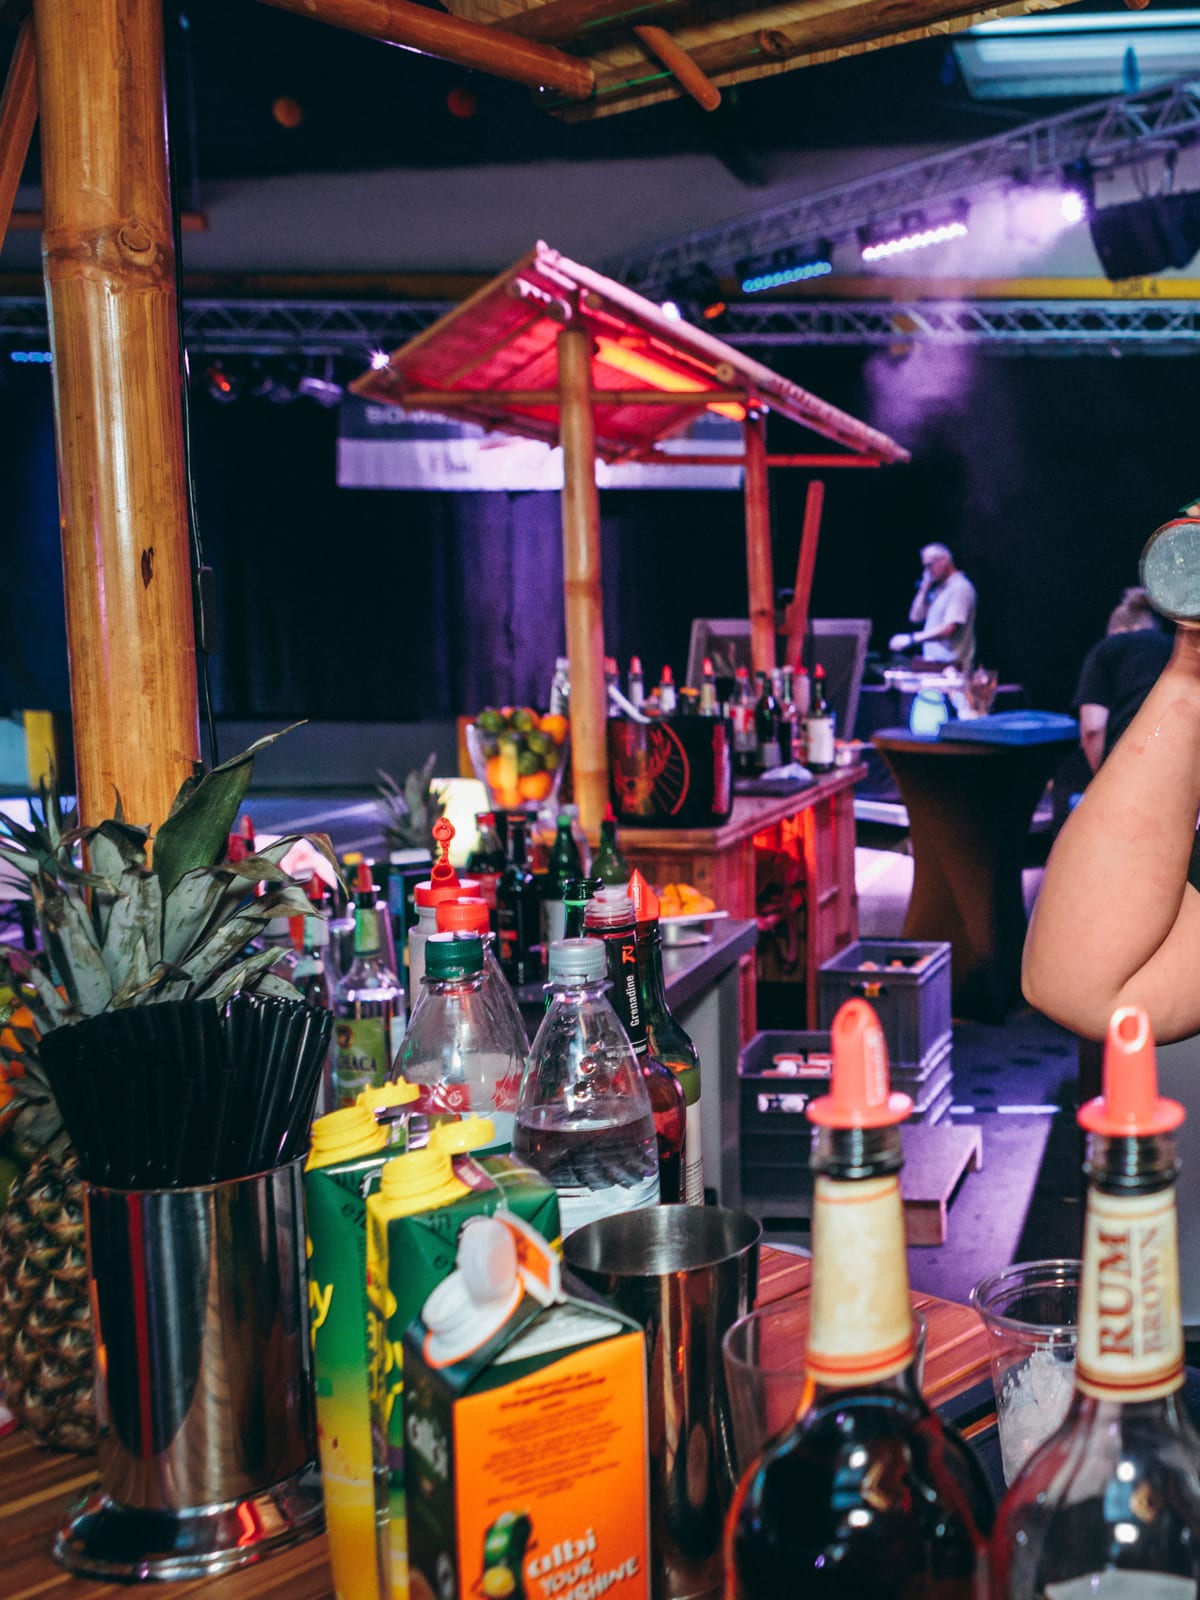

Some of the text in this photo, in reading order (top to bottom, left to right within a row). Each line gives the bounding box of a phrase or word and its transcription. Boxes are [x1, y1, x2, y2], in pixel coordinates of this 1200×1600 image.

[626, 974, 640, 1028] Grenadine
[1097, 1230, 1134, 1357] RUM
[1140, 1227, 1161, 1355] BROWN
[528, 1527, 597, 1578] albi
[540, 1557, 595, 1597] YOUR
